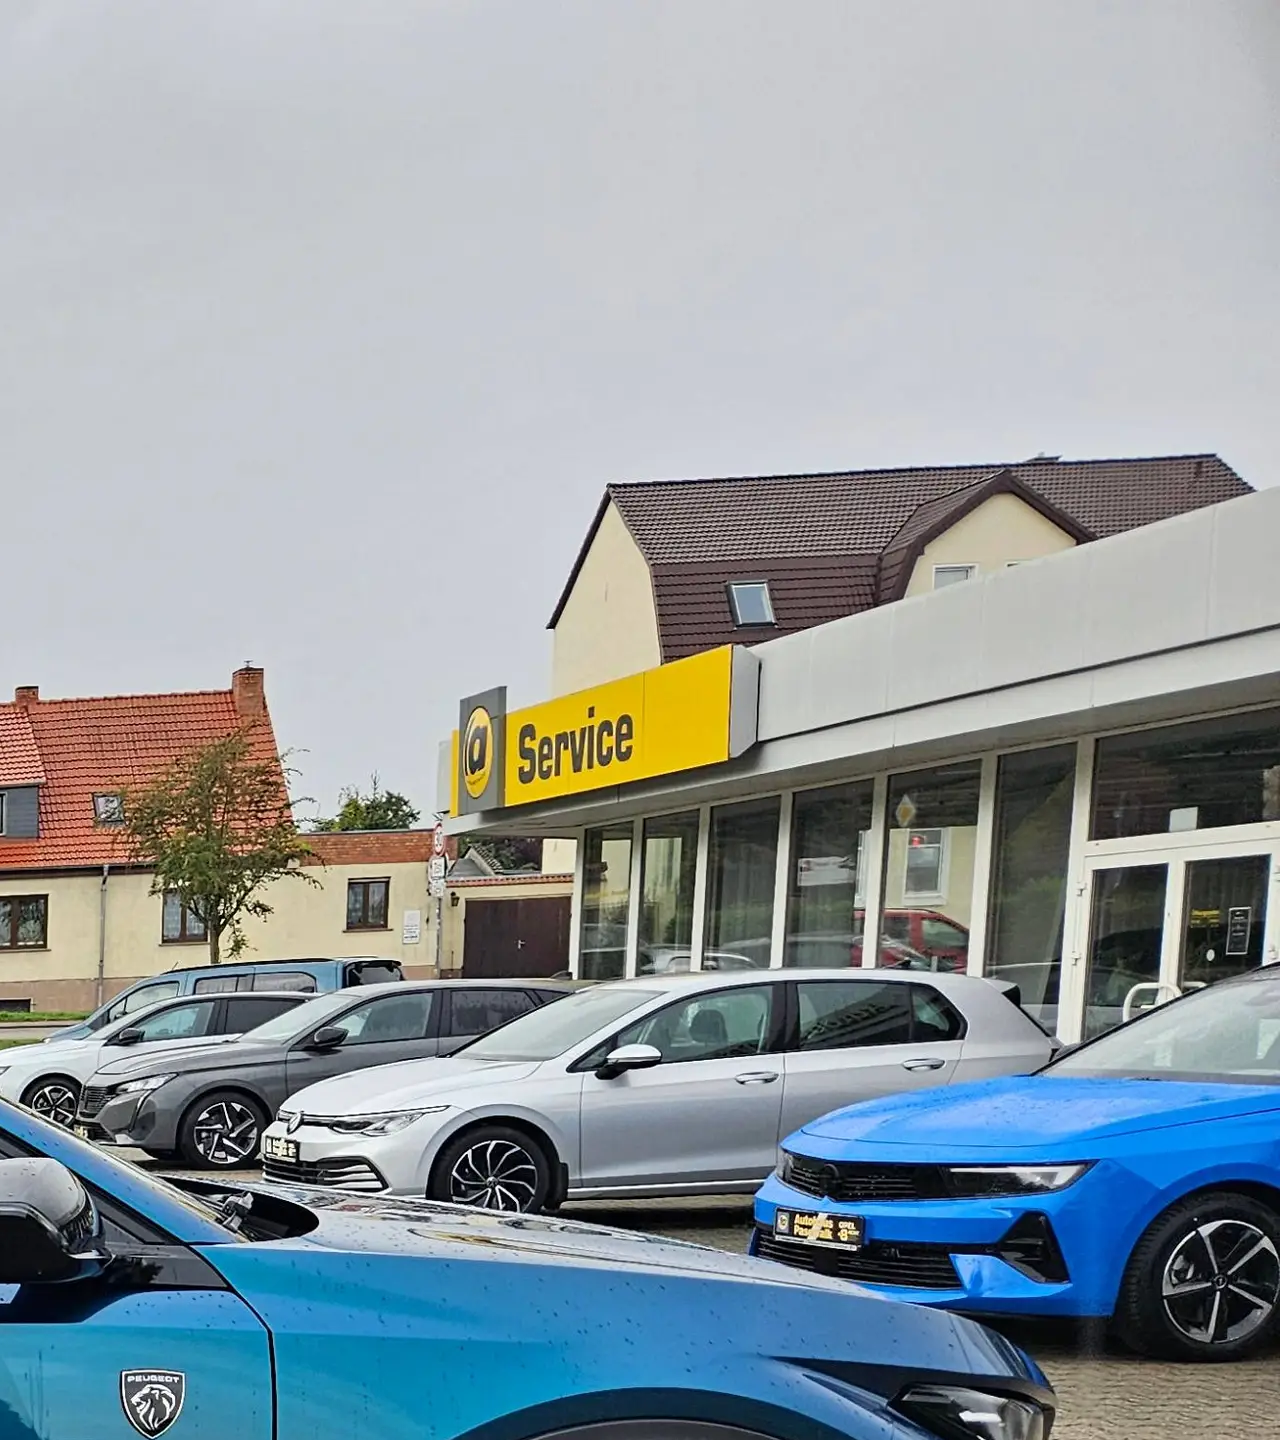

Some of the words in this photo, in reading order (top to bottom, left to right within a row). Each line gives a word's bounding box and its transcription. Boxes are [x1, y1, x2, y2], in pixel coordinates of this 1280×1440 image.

[517, 706, 634, 785] Service
[838, 1221, 856, 1230] OPEL
[127, 1374, 180, 1384] PEUGEOT
